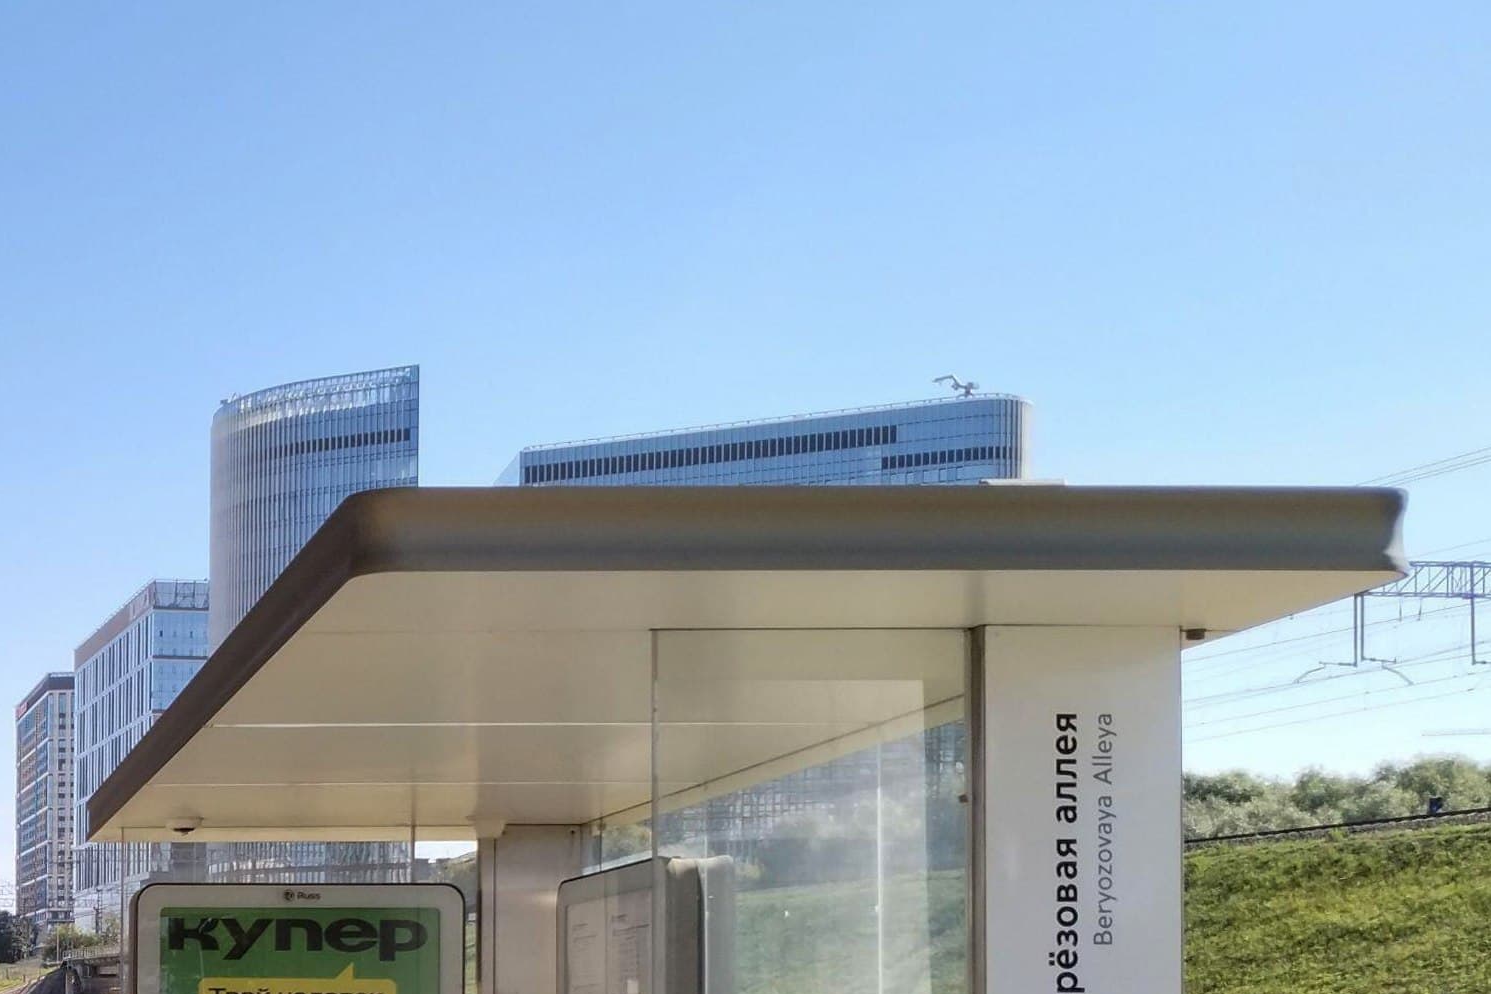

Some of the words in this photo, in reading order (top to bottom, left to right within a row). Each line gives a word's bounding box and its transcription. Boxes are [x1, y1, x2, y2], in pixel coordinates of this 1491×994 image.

[1055, 712, 1077, 824] аллея
[1092, 712, 1117, 785] Alleya
[1093, 795, 1117, 946] Beryozovaya
[168, 917, 429, 962] купер
